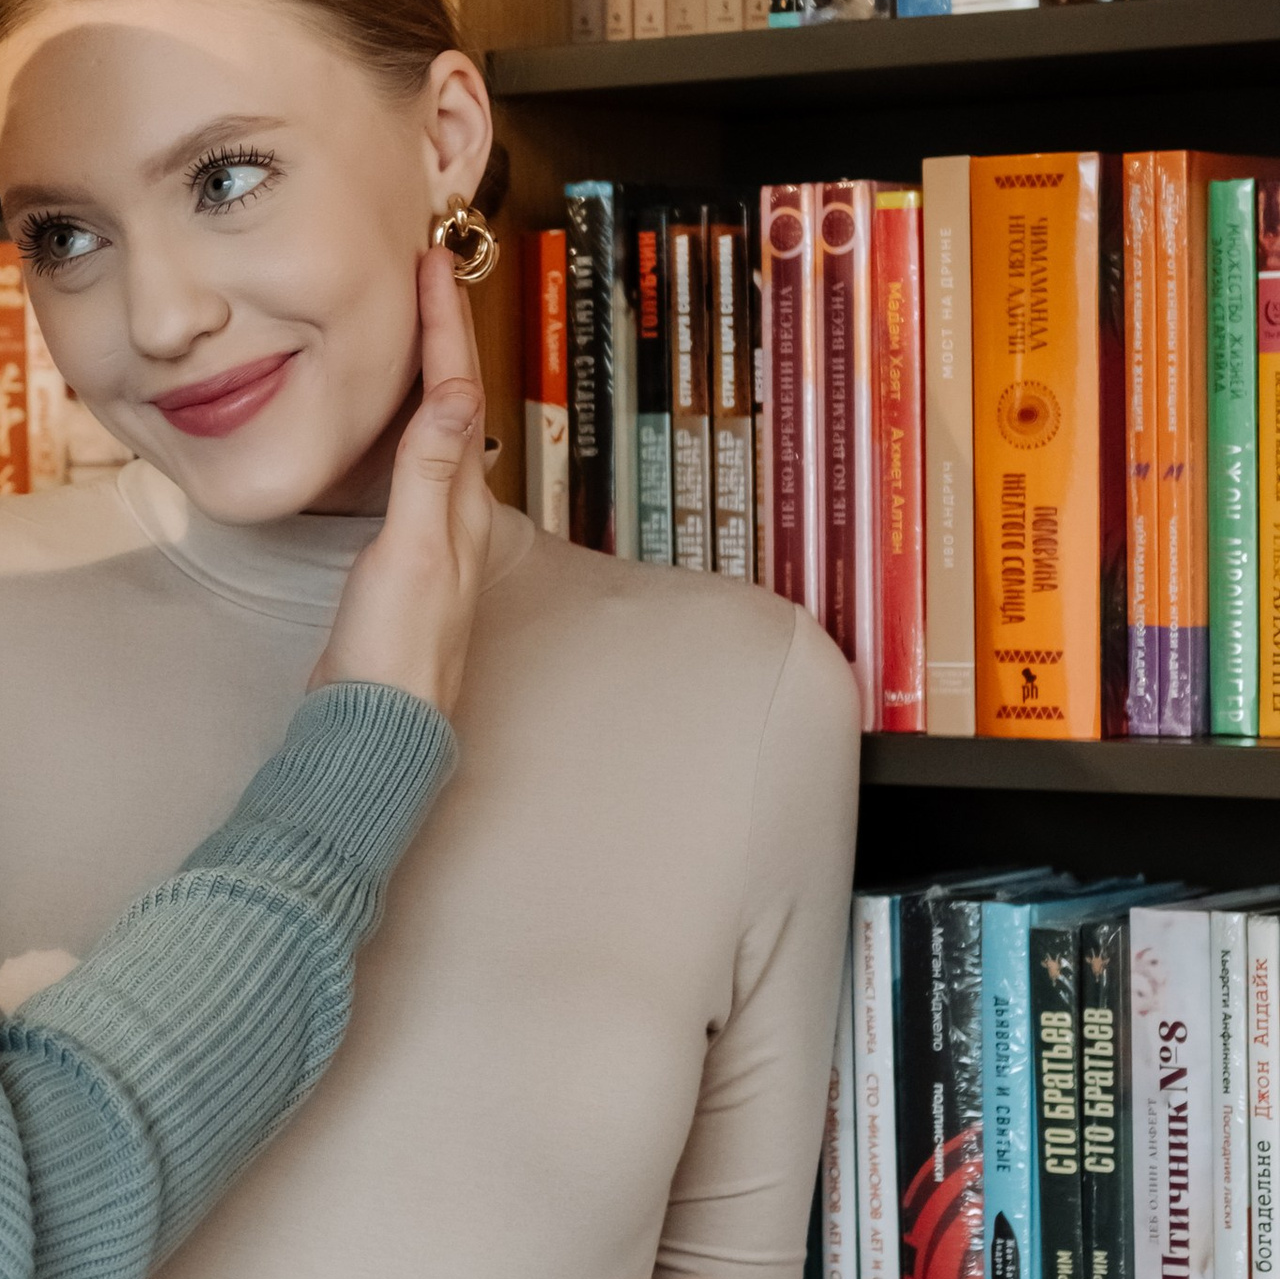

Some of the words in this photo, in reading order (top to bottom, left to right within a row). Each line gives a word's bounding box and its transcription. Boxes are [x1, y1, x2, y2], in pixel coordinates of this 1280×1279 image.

[940, 227, 954, 289] ДРИНЕ
[1008, 215, 1025, 278] НГОЗИ
[1226, 224, 1242, 323] МНОЖЕСТВО
[831, 281, 845, 350] ВЕСНА
[887, 280, 906, 349] Мадам
[942, 296, 953, 319] НА
[1030, 217, 1048, 352] ЧИМАМАНДА
[780, 285, 794, 354] ВЕСНА
[1006, 286, 1024, 355] АДИЧИ
[889, 356, 902, 401] Хаят
[941, 328, 954, 379] МОСТ
[1229, 332, 1246, 401] ЖИЗНЕЙ
[780, 361, 794, 461] ВРЕМЕНИ
[831, 357, 846, 459] ВРЕМЕНИ
[781, 466, 794, 494] КО
[832, 464, 846, 490] КО
[889, 427, 905, 490] Ахмет
[781, 500, 795, 528] НЕ
[833, 497, 846, 525] НЕ
[891, 495, 905, 554] Алтан
[943, 461, 954, 529] АНДРИЧ
[1001, 473, 1026, 550] ЖЕЛТОГО
[944, 535, 954, 568] ИВО
[1031, 506, 1059, 593] ПОЛОВИНА
[1000, 556, 1026, 625] СОЛНЦА
[931, 926, 945, 978] Меган
[1220, 949, 1232, 1008] Кьерсти
[865, 1006, 877, 1055] АНДРЕА
[931, 980, 946, 1051] Анджело
[1252, 957, 1272, 1047] Апдайк
[993, 996, 1011, 1078] ДЬЯВОЛЫ
[1158, 1020, 1188, 1092] №8
[1219, 1011, 1233, 1094] Анфиннсен
[866, 1073, 880, 1107] СТО
[996, 1086, 1011, 1097] И
[1254, 1061, 1272, 1121] Джон
[827, 1107, 841, 1213] МИЛЛИОНОВ
[932, 1082, 945, 1183] подписчики
[996, 1105, 1012, 1173] СВЯТЫЕ
[1044, 1128, 1078, 1175] СТО
[1085, 1126, 1115, 1174] СТО
[1147, 1098, 1158, 1161] АНФЕРТ
[1222, 1105, 1233, 1183] Последние
[867, 1114, 882, 1221] МИЛЛИОНОВ
[1148, 1165, 1159, 1210] ОЛИН
[829, 1221, 841, 1247] ЛЕТ
[1149, 1216, 1159, 1243] ДЕБ
[1223, 1187, 1233, 1229] ласки
[1253, 1140, 1277, 1273] богадельне
[830, 1254, 841, 1263] И
[870, 1227, 883, 1255] ЛЕТ
[871, 1260, 883, 1270] И
[994, 1238, 1004, 1276] Андреа
